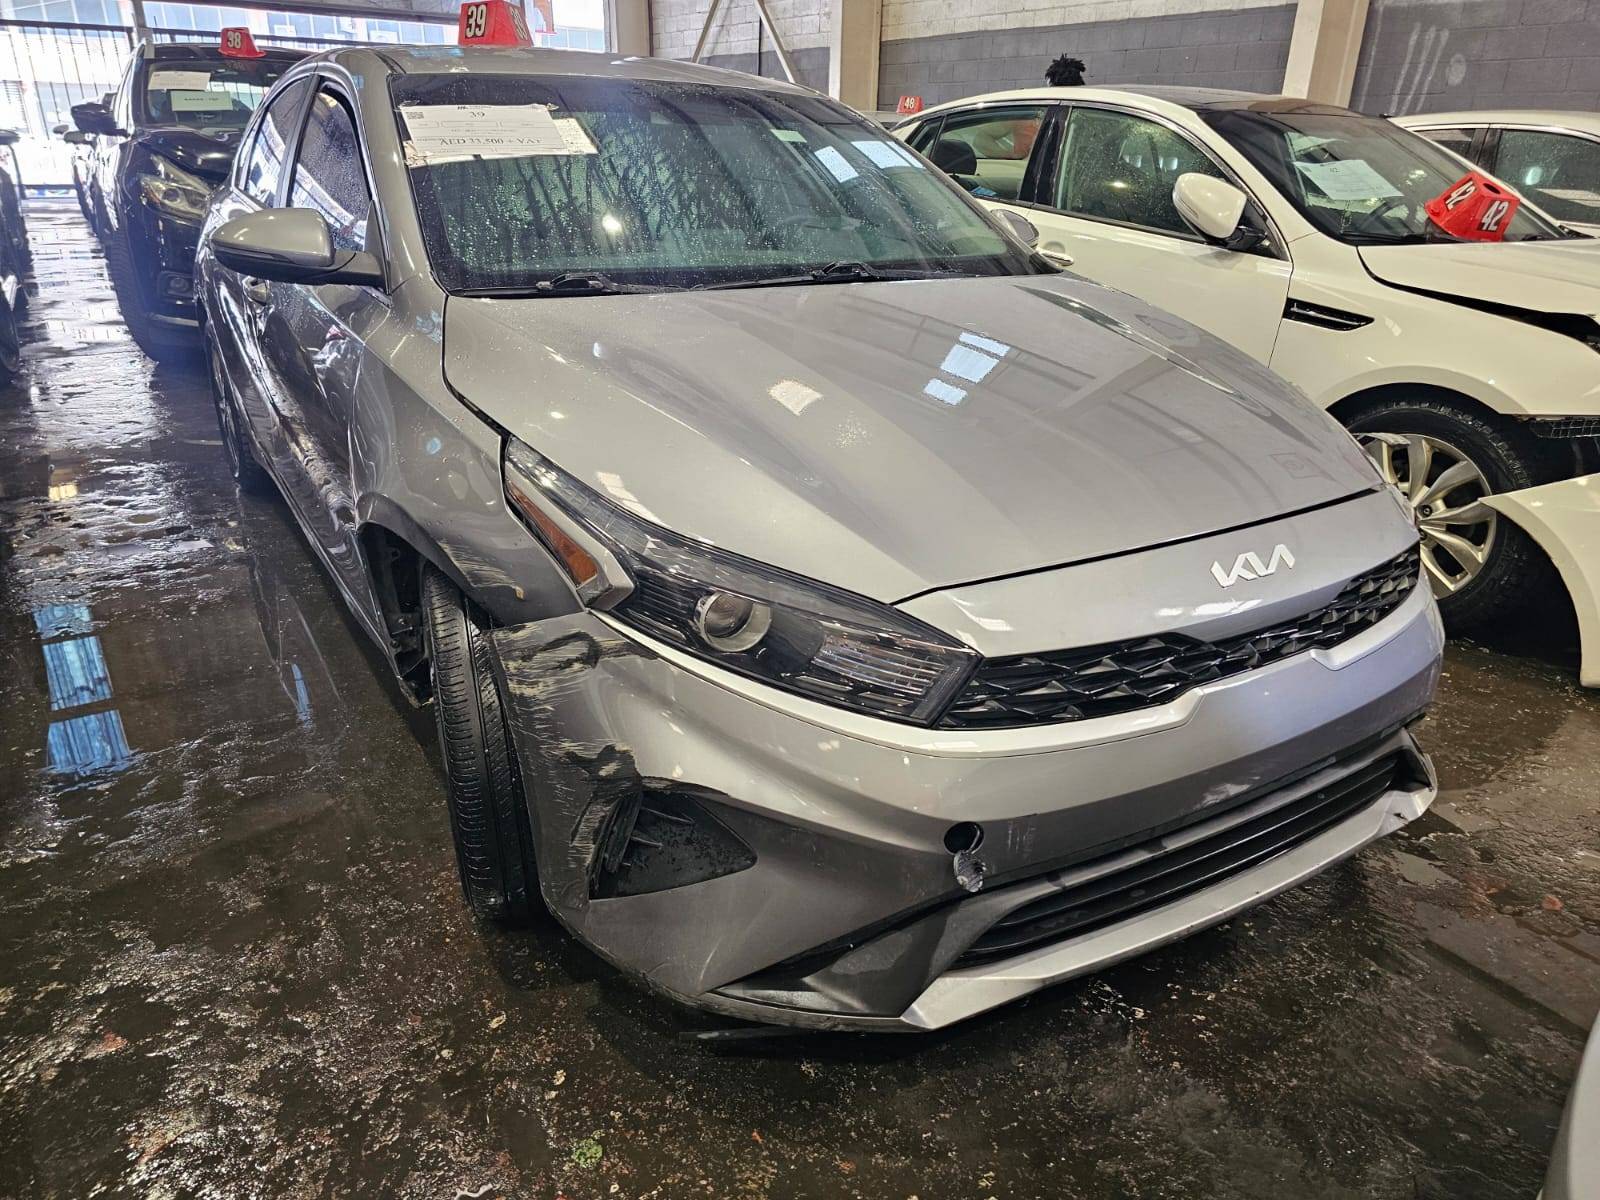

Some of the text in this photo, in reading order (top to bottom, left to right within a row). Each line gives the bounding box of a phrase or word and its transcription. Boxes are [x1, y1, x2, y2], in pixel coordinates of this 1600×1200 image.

[466, 4, 487, 38] 39
[227, 31, 241, 49] 38
[904, 97, 915, 109] 48
[440, 138, 466, 146] AED
[1445, 180, 1476, 211] 42
[1480, 200, 1509, 232] 42
[1210, 543, 1295, 588] KIA
